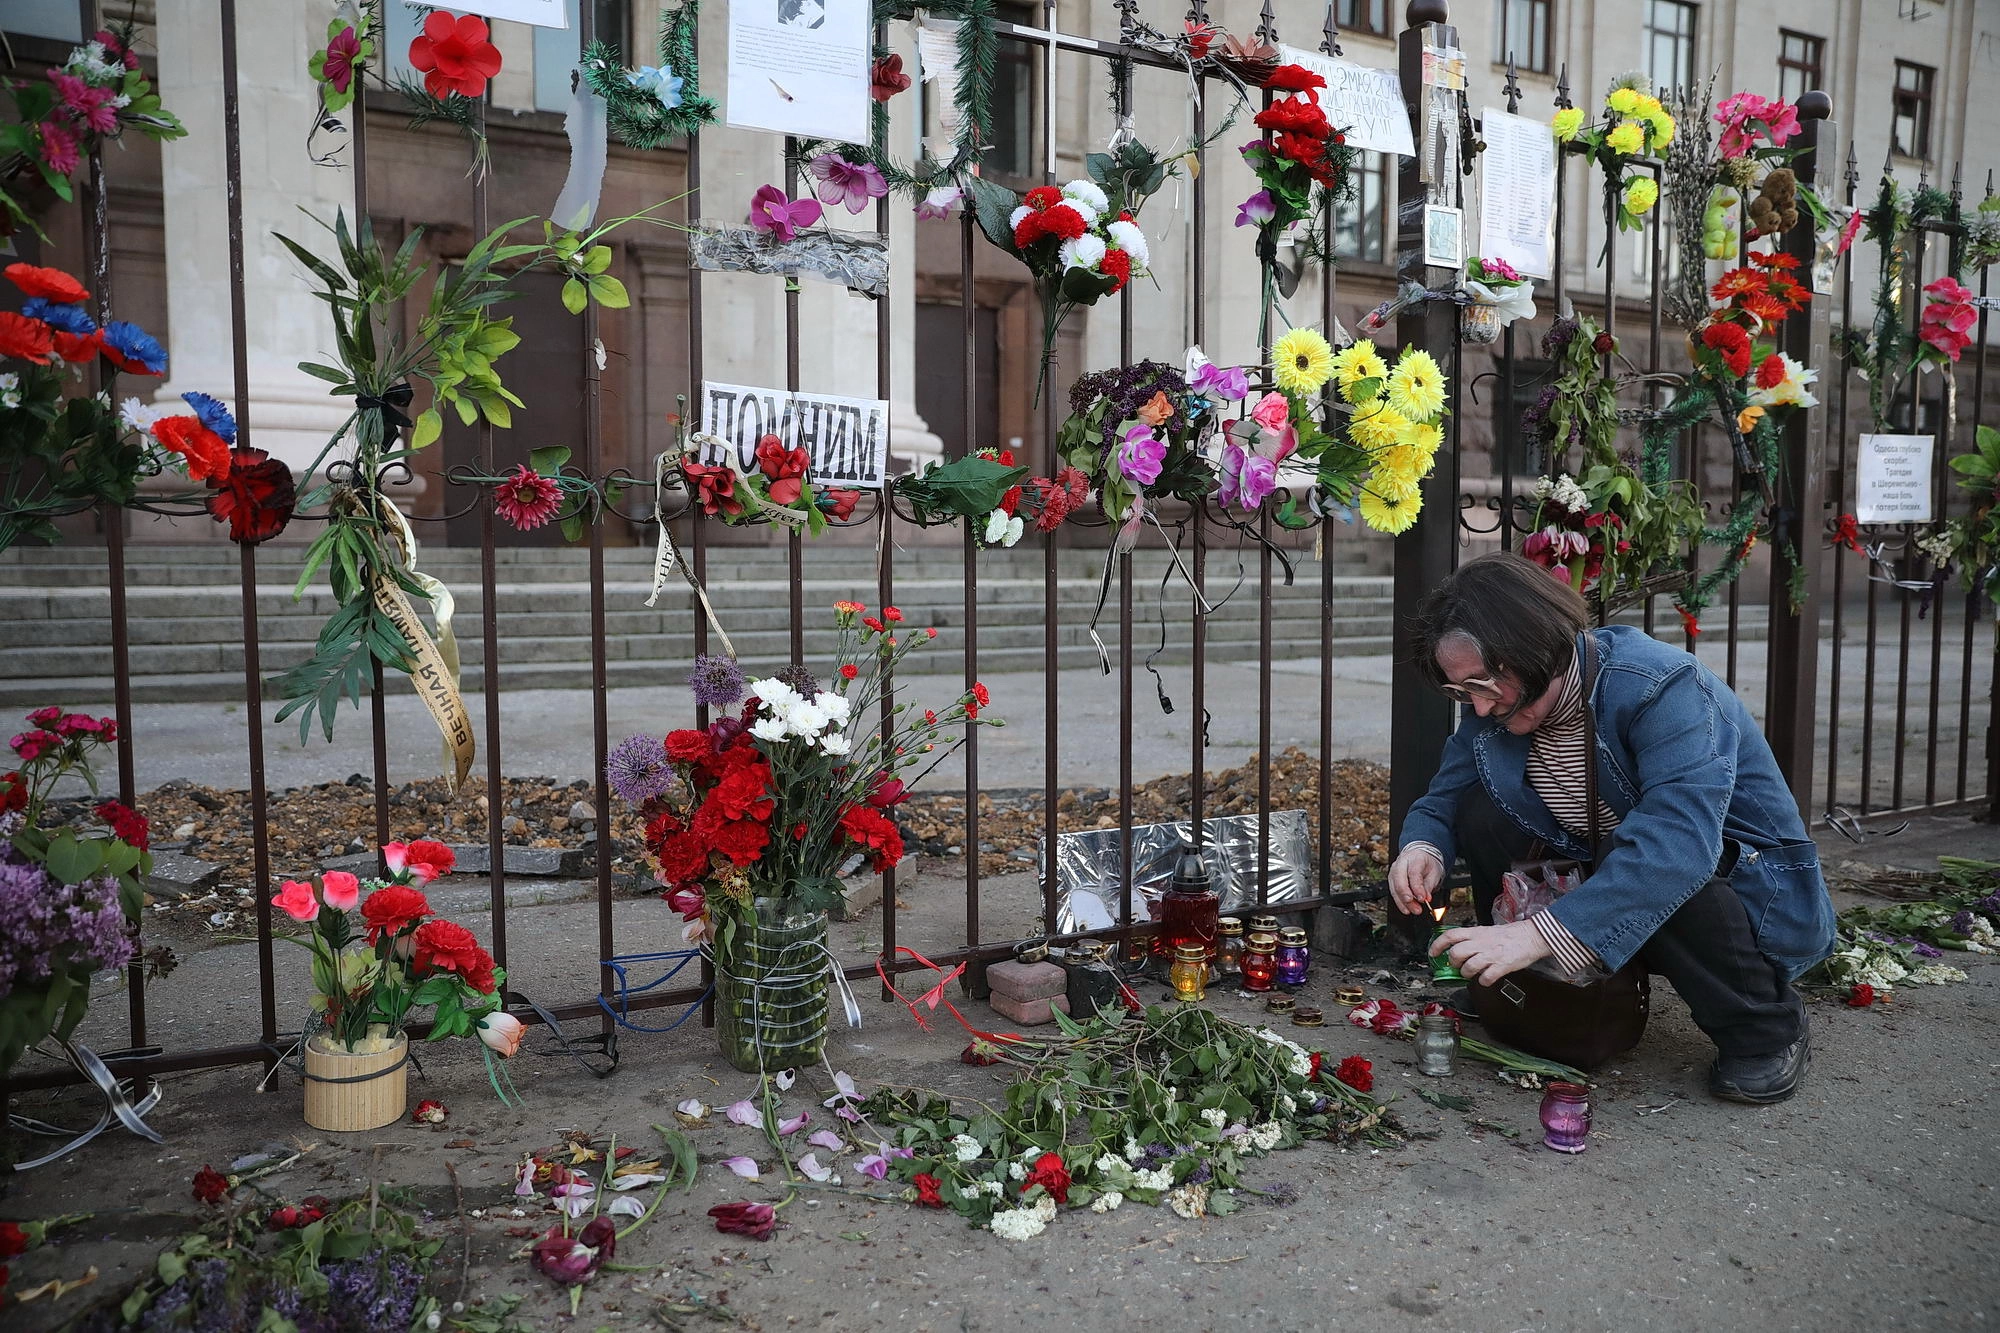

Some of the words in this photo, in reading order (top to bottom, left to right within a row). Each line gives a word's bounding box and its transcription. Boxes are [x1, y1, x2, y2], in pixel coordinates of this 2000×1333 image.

[704, 389, 881, 481] ПОМНИМ
[1874, 444, 1898, 455] Одесса
[1899, 445, 1921, 456] глубоко
[1900, 491, 1912, 499] боль
[419, 663, 468, 746] ВЕЧНАЯ
